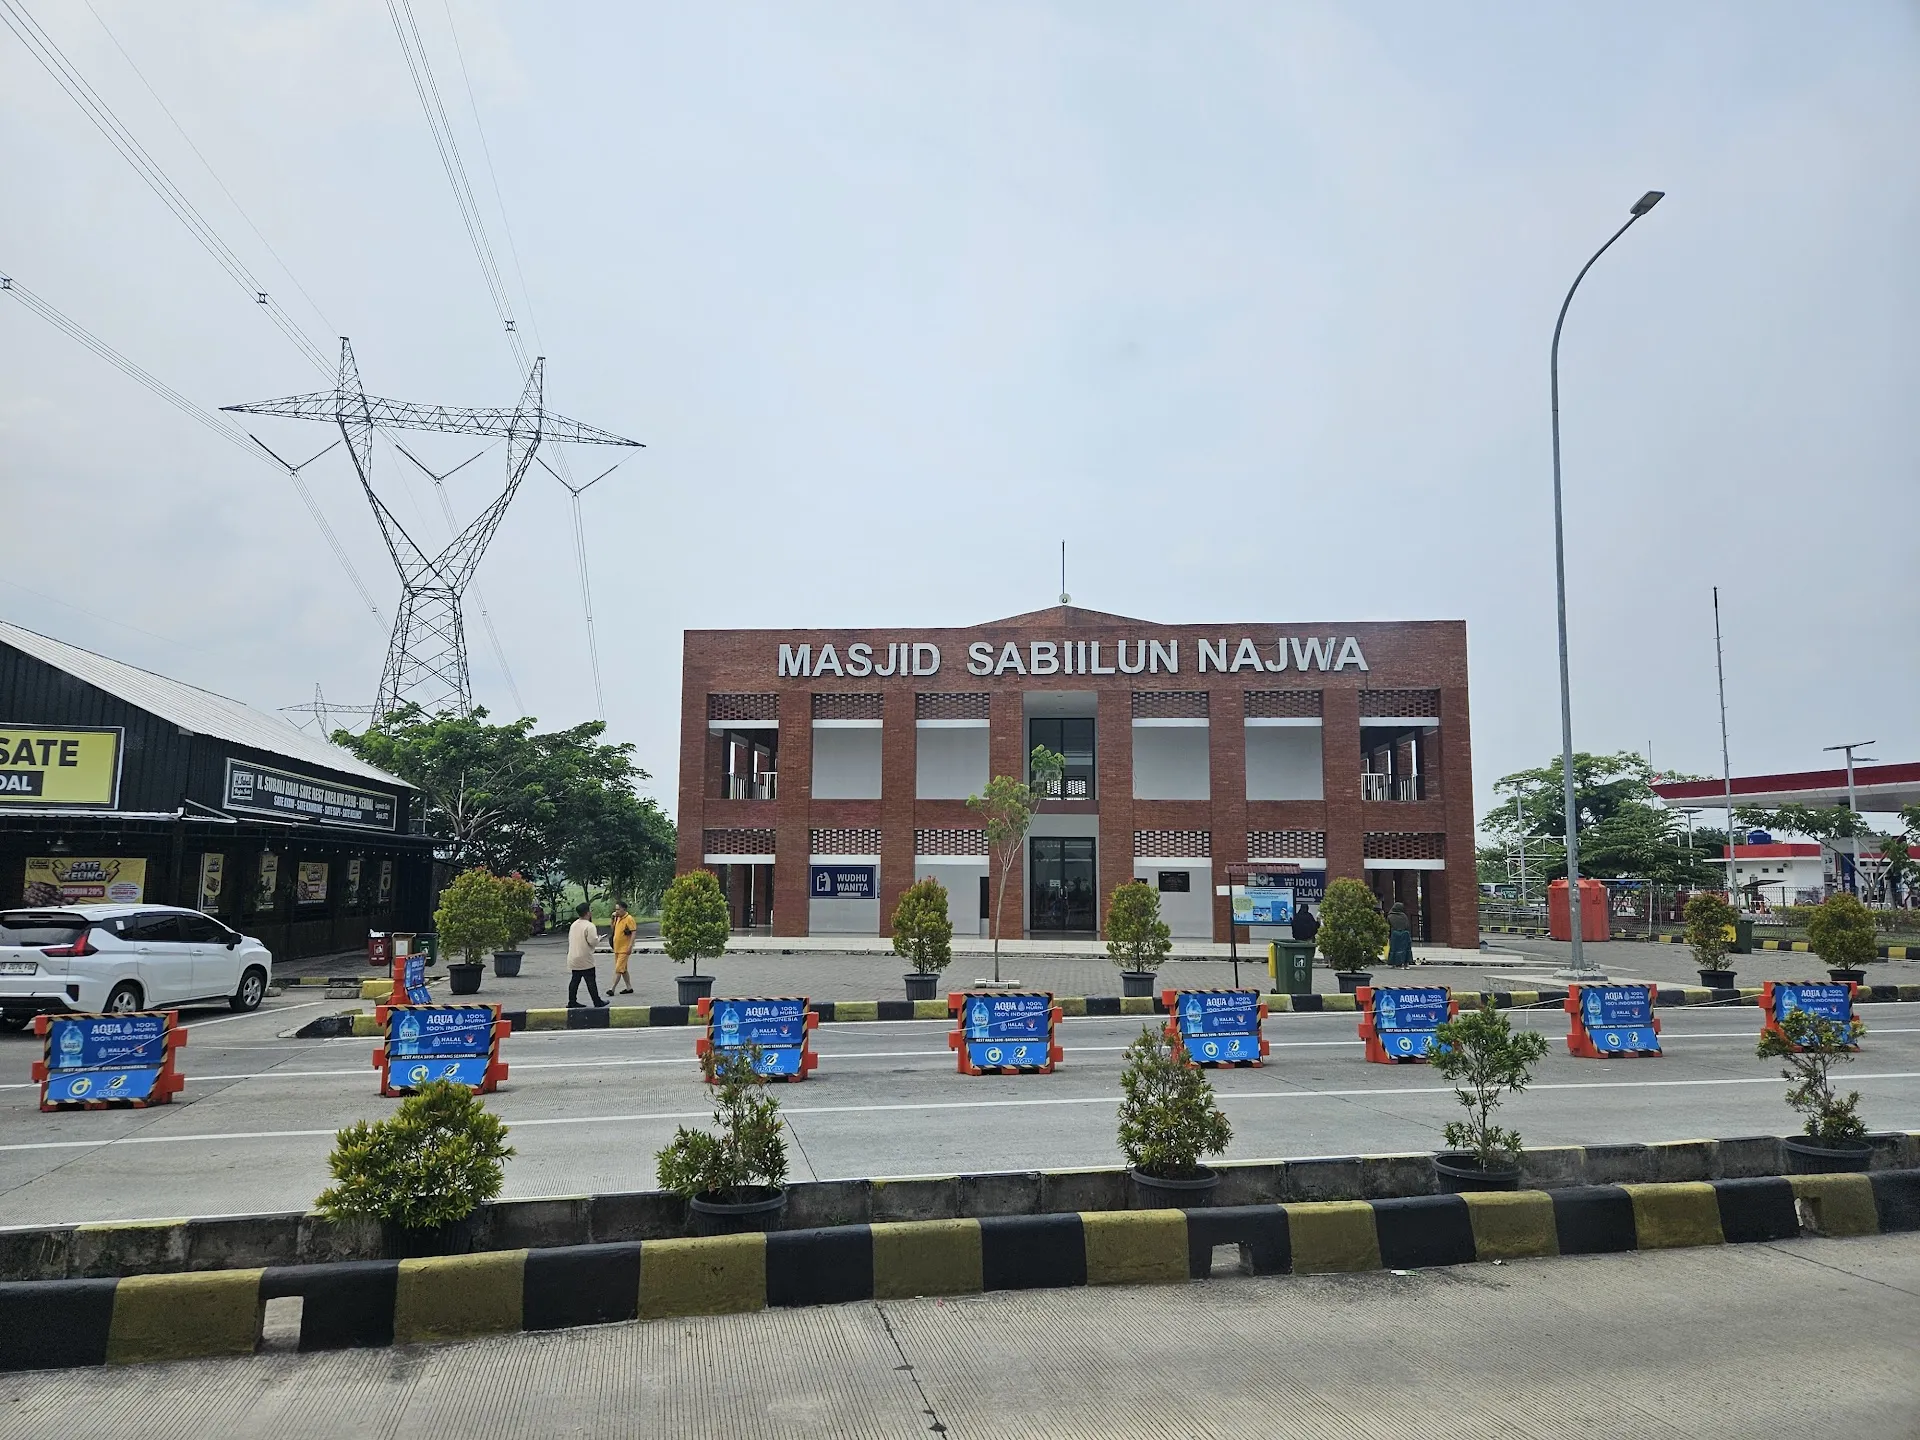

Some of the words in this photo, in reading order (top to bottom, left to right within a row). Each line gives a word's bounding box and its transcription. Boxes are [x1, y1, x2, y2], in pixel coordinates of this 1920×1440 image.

[778, 642, 940, 678] MASJID
[966, 639, 1179, 676] SABIILUN
[1198, 636, 1369, 674] NAJWA
[257, 774, 263, 790] H.
[264, 776, 285, 794] SUBALI
[299, 784, 312, 800] SATE
[312, 787, 324, 802] REST
[324, 790, 336, 804] AREA
[274, 795, 284, 806] SATE
[297, 800, 306, 810] SATE
[72, 861, 100, 870] SATE
[64, 872, 106, 881] KELINCI
[1284, 878, 1317, 886] WUDHU
[836, 883, 868, 891] WANITA
[1605, 992, 1623, 1001] AQUA
[1801, 990, 1820, 998] AQUA
[1206, 998, 1227, 1007] AQUA
[1400, 995, 1419, 1003] AQUA
[745, 1007, 770, 1016] AQUA
[994, 1002, 1017, 1012] AQUA
[427, 1014, 453, 1025] AQUA
[91, 1024, 122, 1035] AQUA
